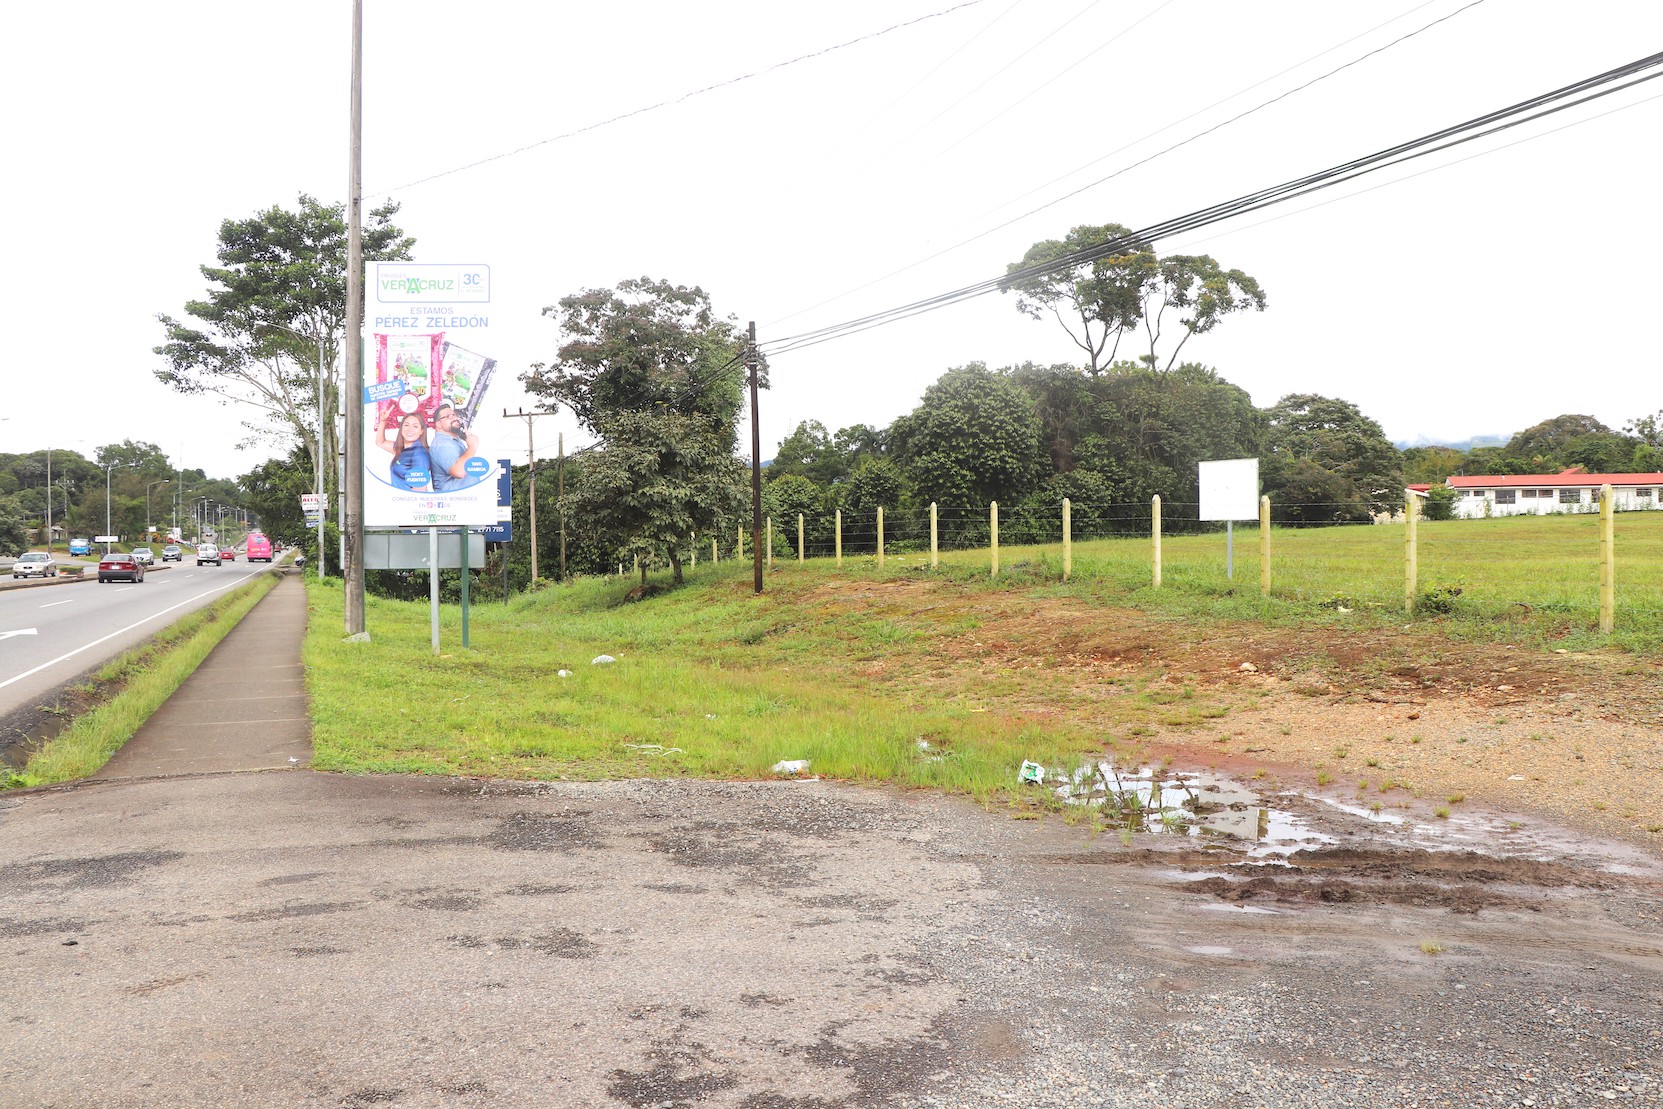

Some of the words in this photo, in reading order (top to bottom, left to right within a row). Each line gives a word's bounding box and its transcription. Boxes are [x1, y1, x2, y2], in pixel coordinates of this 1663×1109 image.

[381, 278, 454, 294] VERACRUZ
[410, 306, 454, 315] ESTAMOS
[375, 314, 419, 329] PÉREZ
[425, 314, 489, 329] ZELEDÓN
[368, 381, 401, 394] BUSQUE
[413, 514, 457, 523] VERACRUZ
